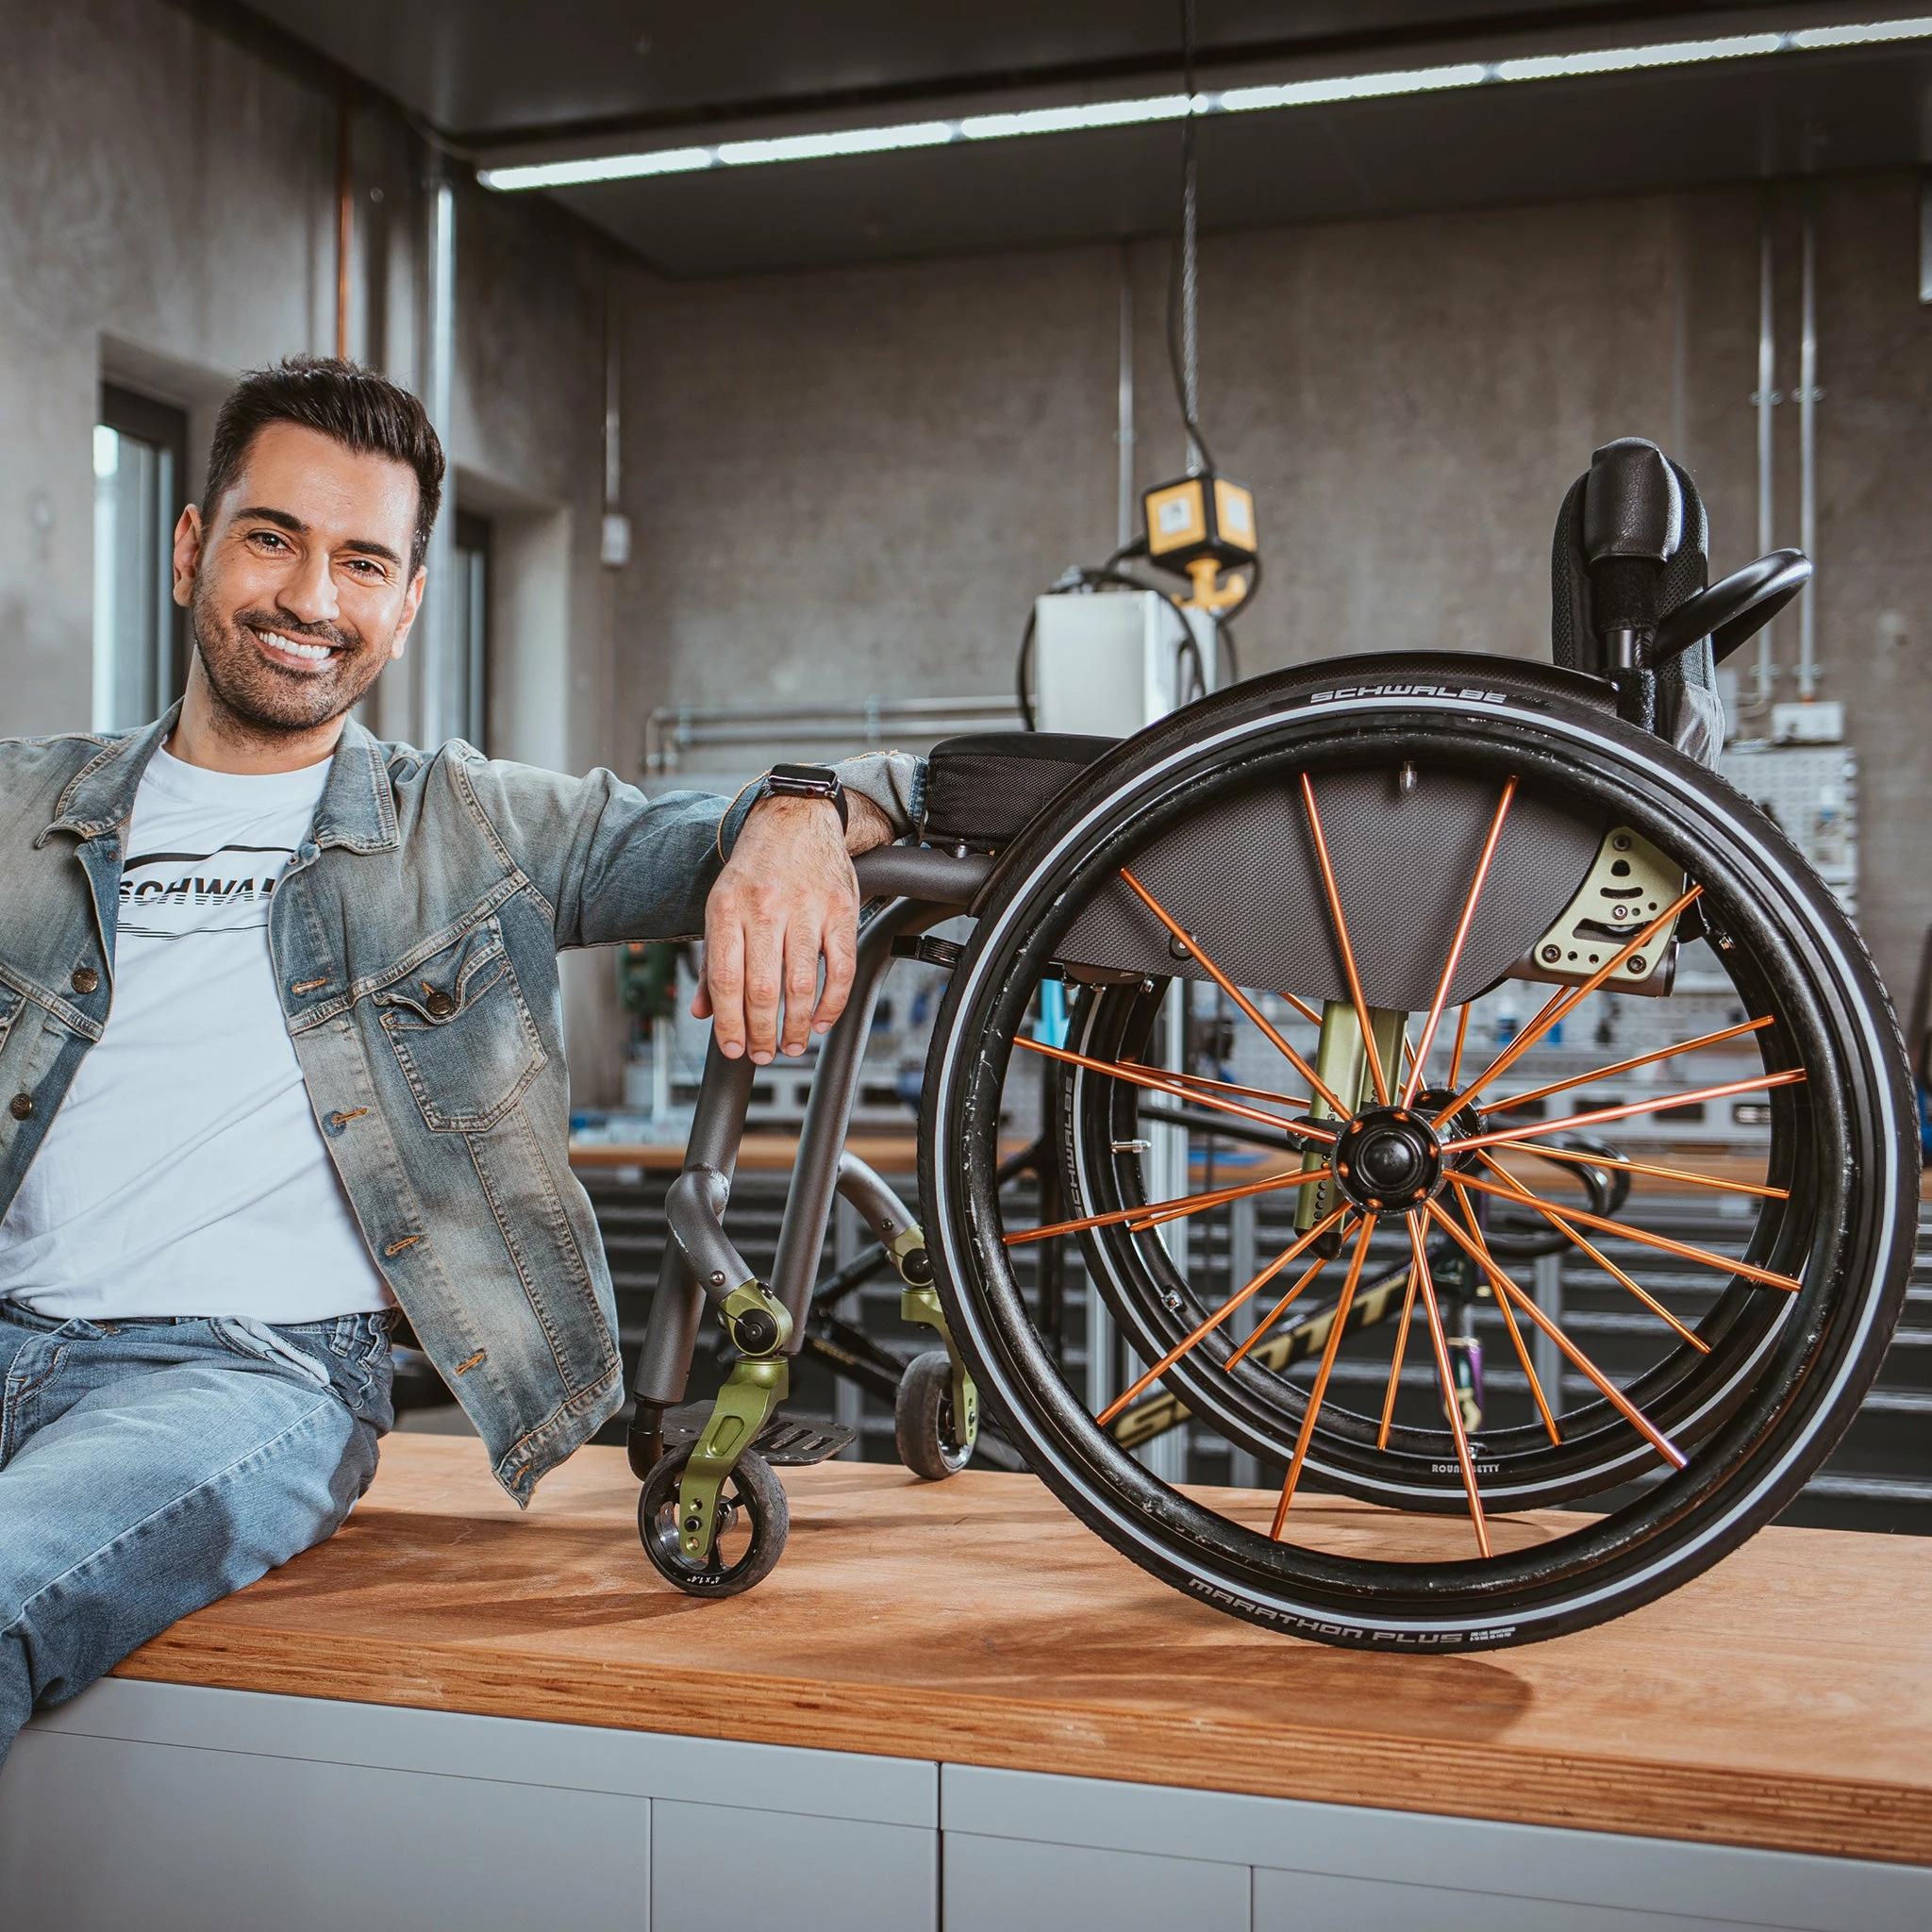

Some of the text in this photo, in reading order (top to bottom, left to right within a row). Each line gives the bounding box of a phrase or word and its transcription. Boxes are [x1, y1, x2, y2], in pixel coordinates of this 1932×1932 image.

[1309, 685, 1507, 705] SCHWALBE
[1062, 1075, 1087, 1220] SCHWALBE
[1431, 1463, 1500, 1474] ROUN ETTY
[1188, 1578, 1463, 1643] MARATHON PLUS
